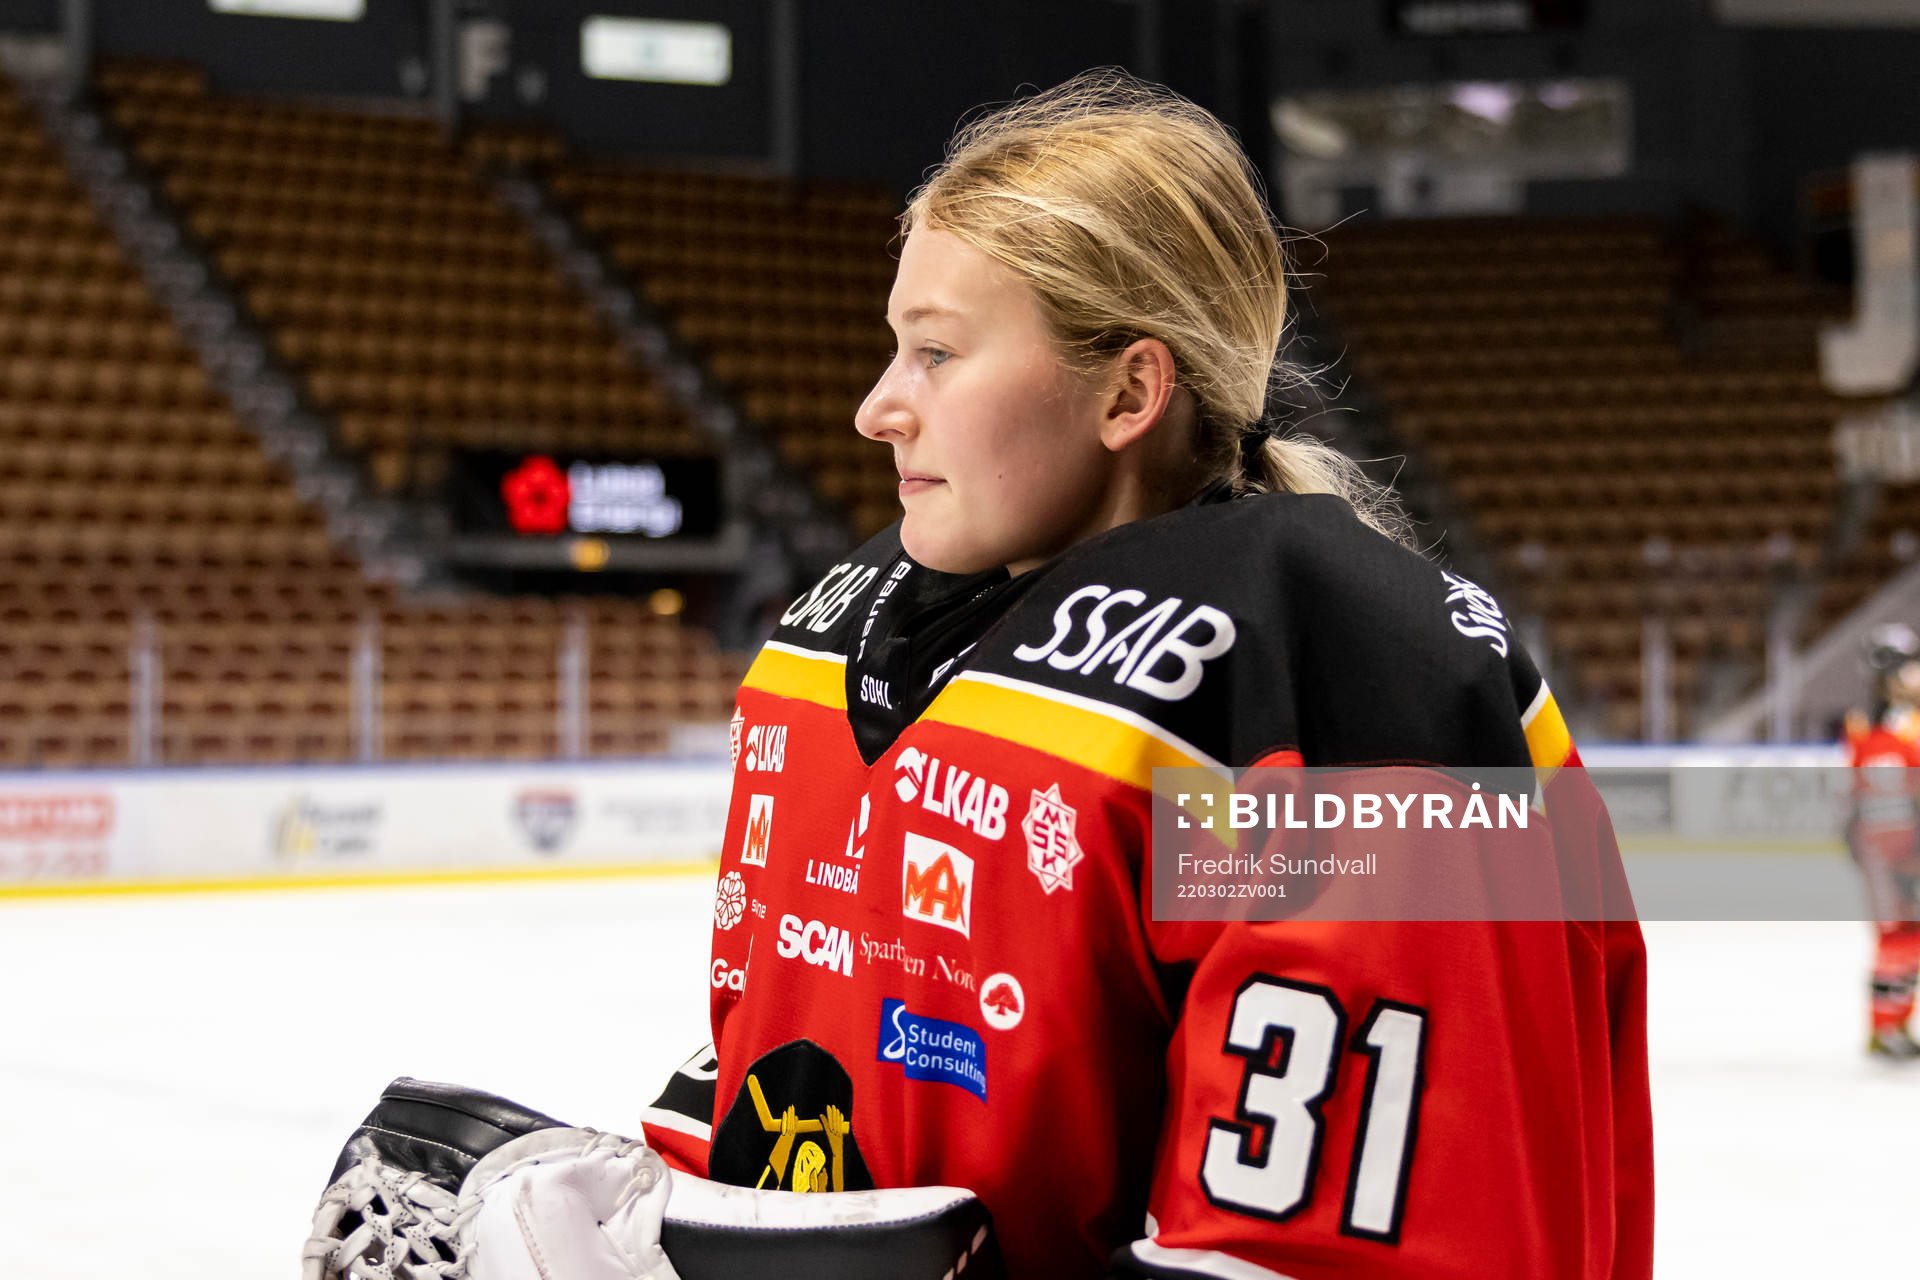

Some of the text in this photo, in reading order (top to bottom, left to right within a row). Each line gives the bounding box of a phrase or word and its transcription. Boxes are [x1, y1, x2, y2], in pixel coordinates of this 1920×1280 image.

[1012, 584, 1236, 701] SSAB
[757, 725, 788, 773] LKAB
[922, 757, 1009, 841] LKAB
[904, 851, 968, 925] MAX
[776, 913, 854, 978] SCAN
[905, 1046, 987, 1094] Consulting
[908, 1023, 976, 1058] Student
[1198, 967, 1427, 1246] 31
